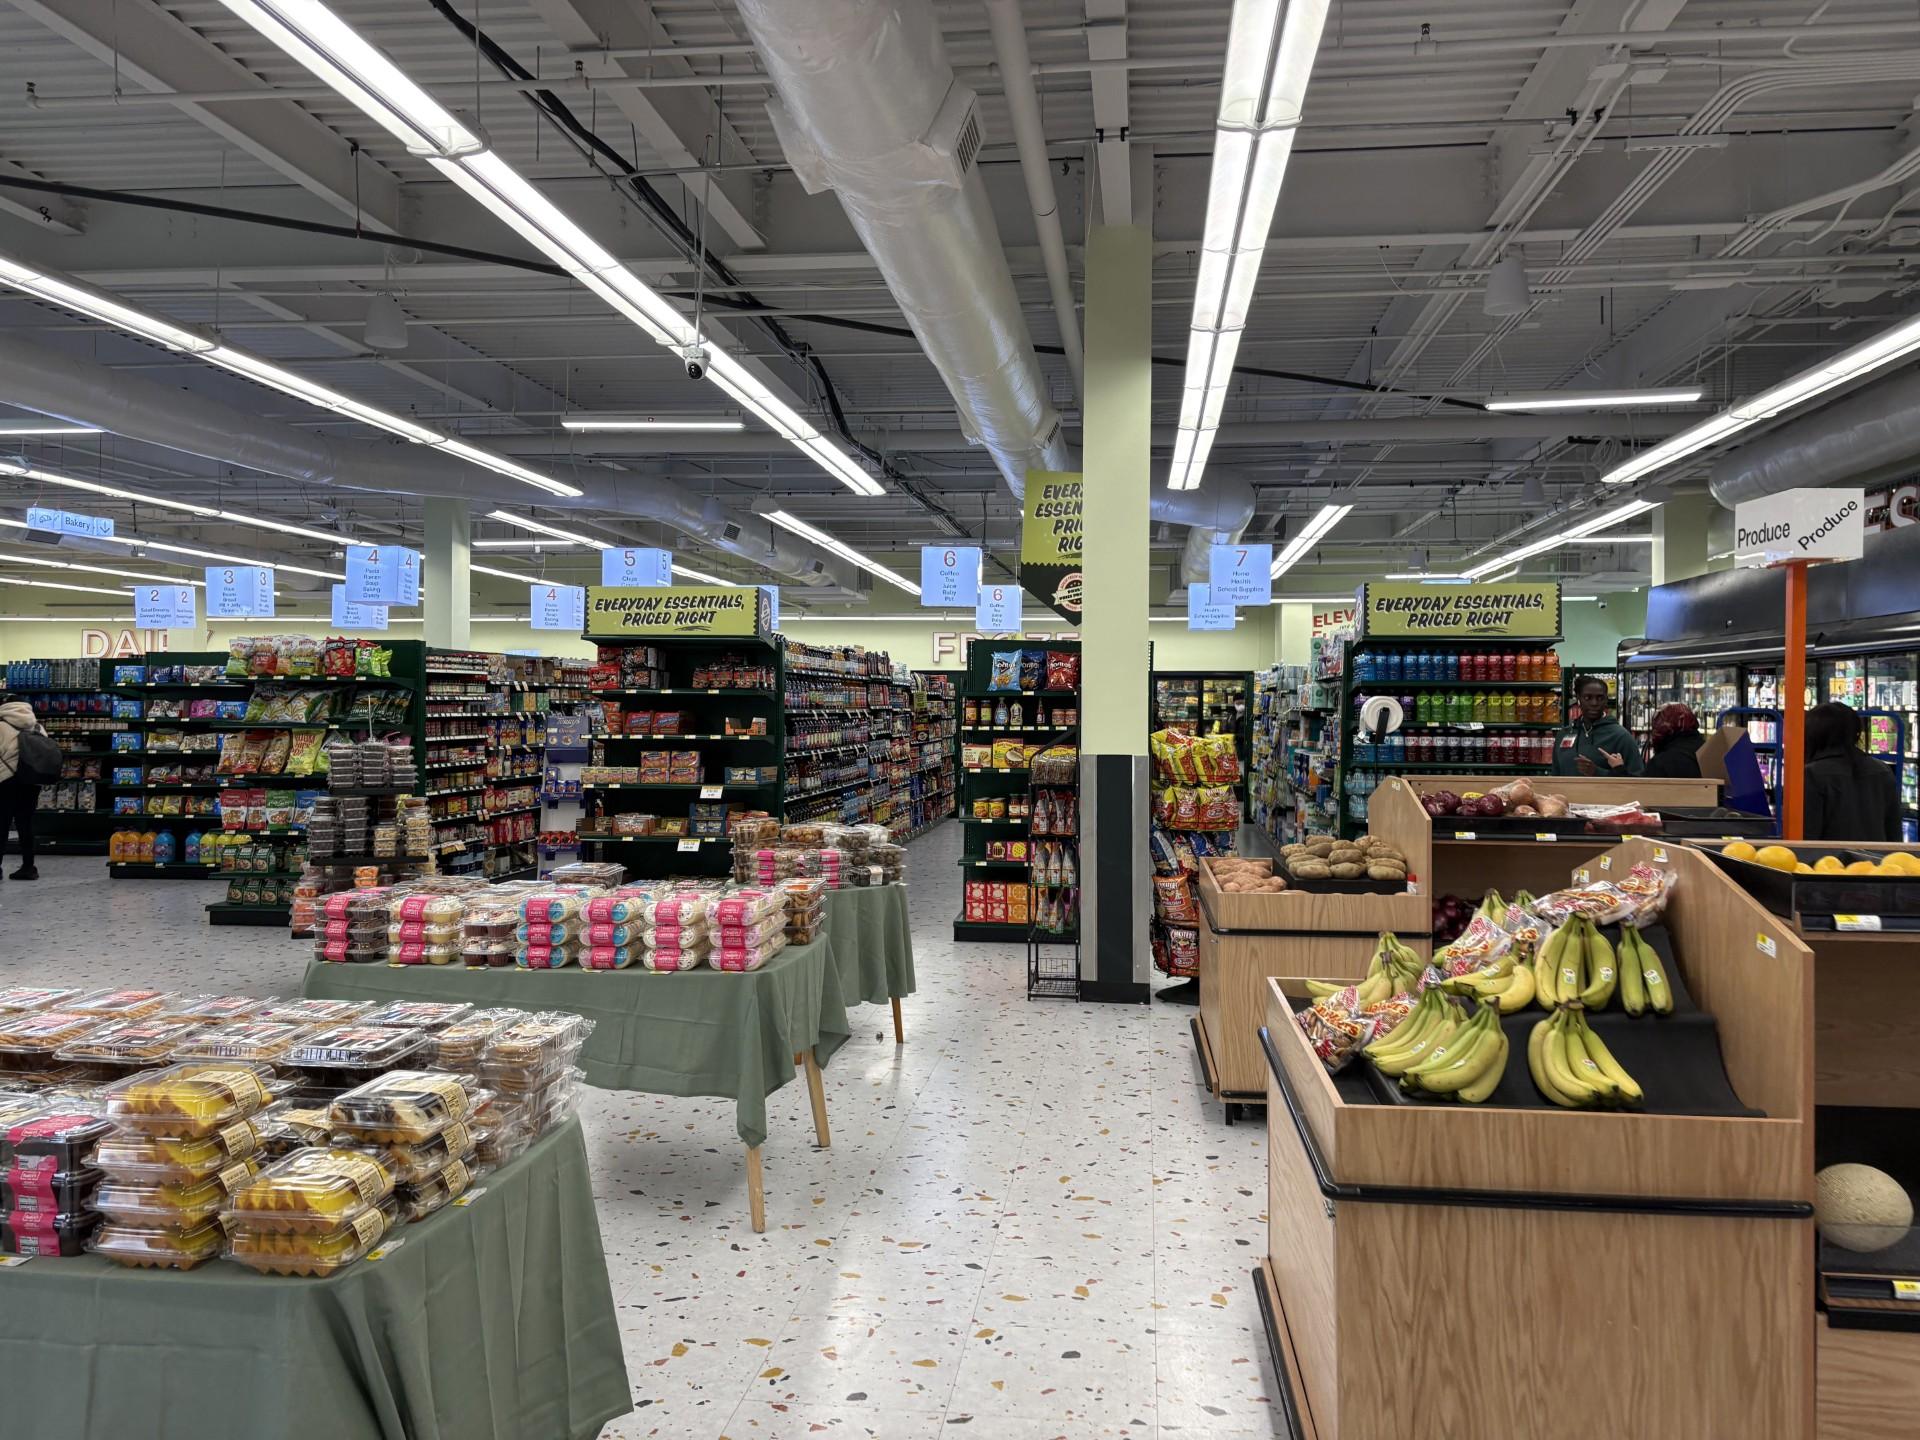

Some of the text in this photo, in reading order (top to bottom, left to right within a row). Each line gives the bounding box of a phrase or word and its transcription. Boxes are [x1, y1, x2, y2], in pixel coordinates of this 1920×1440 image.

[65, 516, 91, 531] Bakery
[1798, 500, 1858, 550] Produce
[1737, 522, 1791, 549] Produce
[368, 549, 379, 565] 4
[405, 554, 412, 569] 4
[624, 551, 636, 566] 5
[944, 550, 956, 567] 6
[1235, 550, 1248, 567] 7
[224, 570, 234, 584] 3
[260, 571, 267, 586] 3
[151, 590, 160, 602] 2
[181, 592, 188, 603] 2
[547, 588, 557, 601] 4
[993, 589, 1003, 602] 6
[594, 593, 745, 612] EVERYDAY ESSENTIALS,
[1375, 593, 1546, 612] EVERYDAY ESSENTIALS,
[622, 610, 717, 627] PRICED RIGHT
[1406, 610, 1513, 628] PRICED RIGHT
